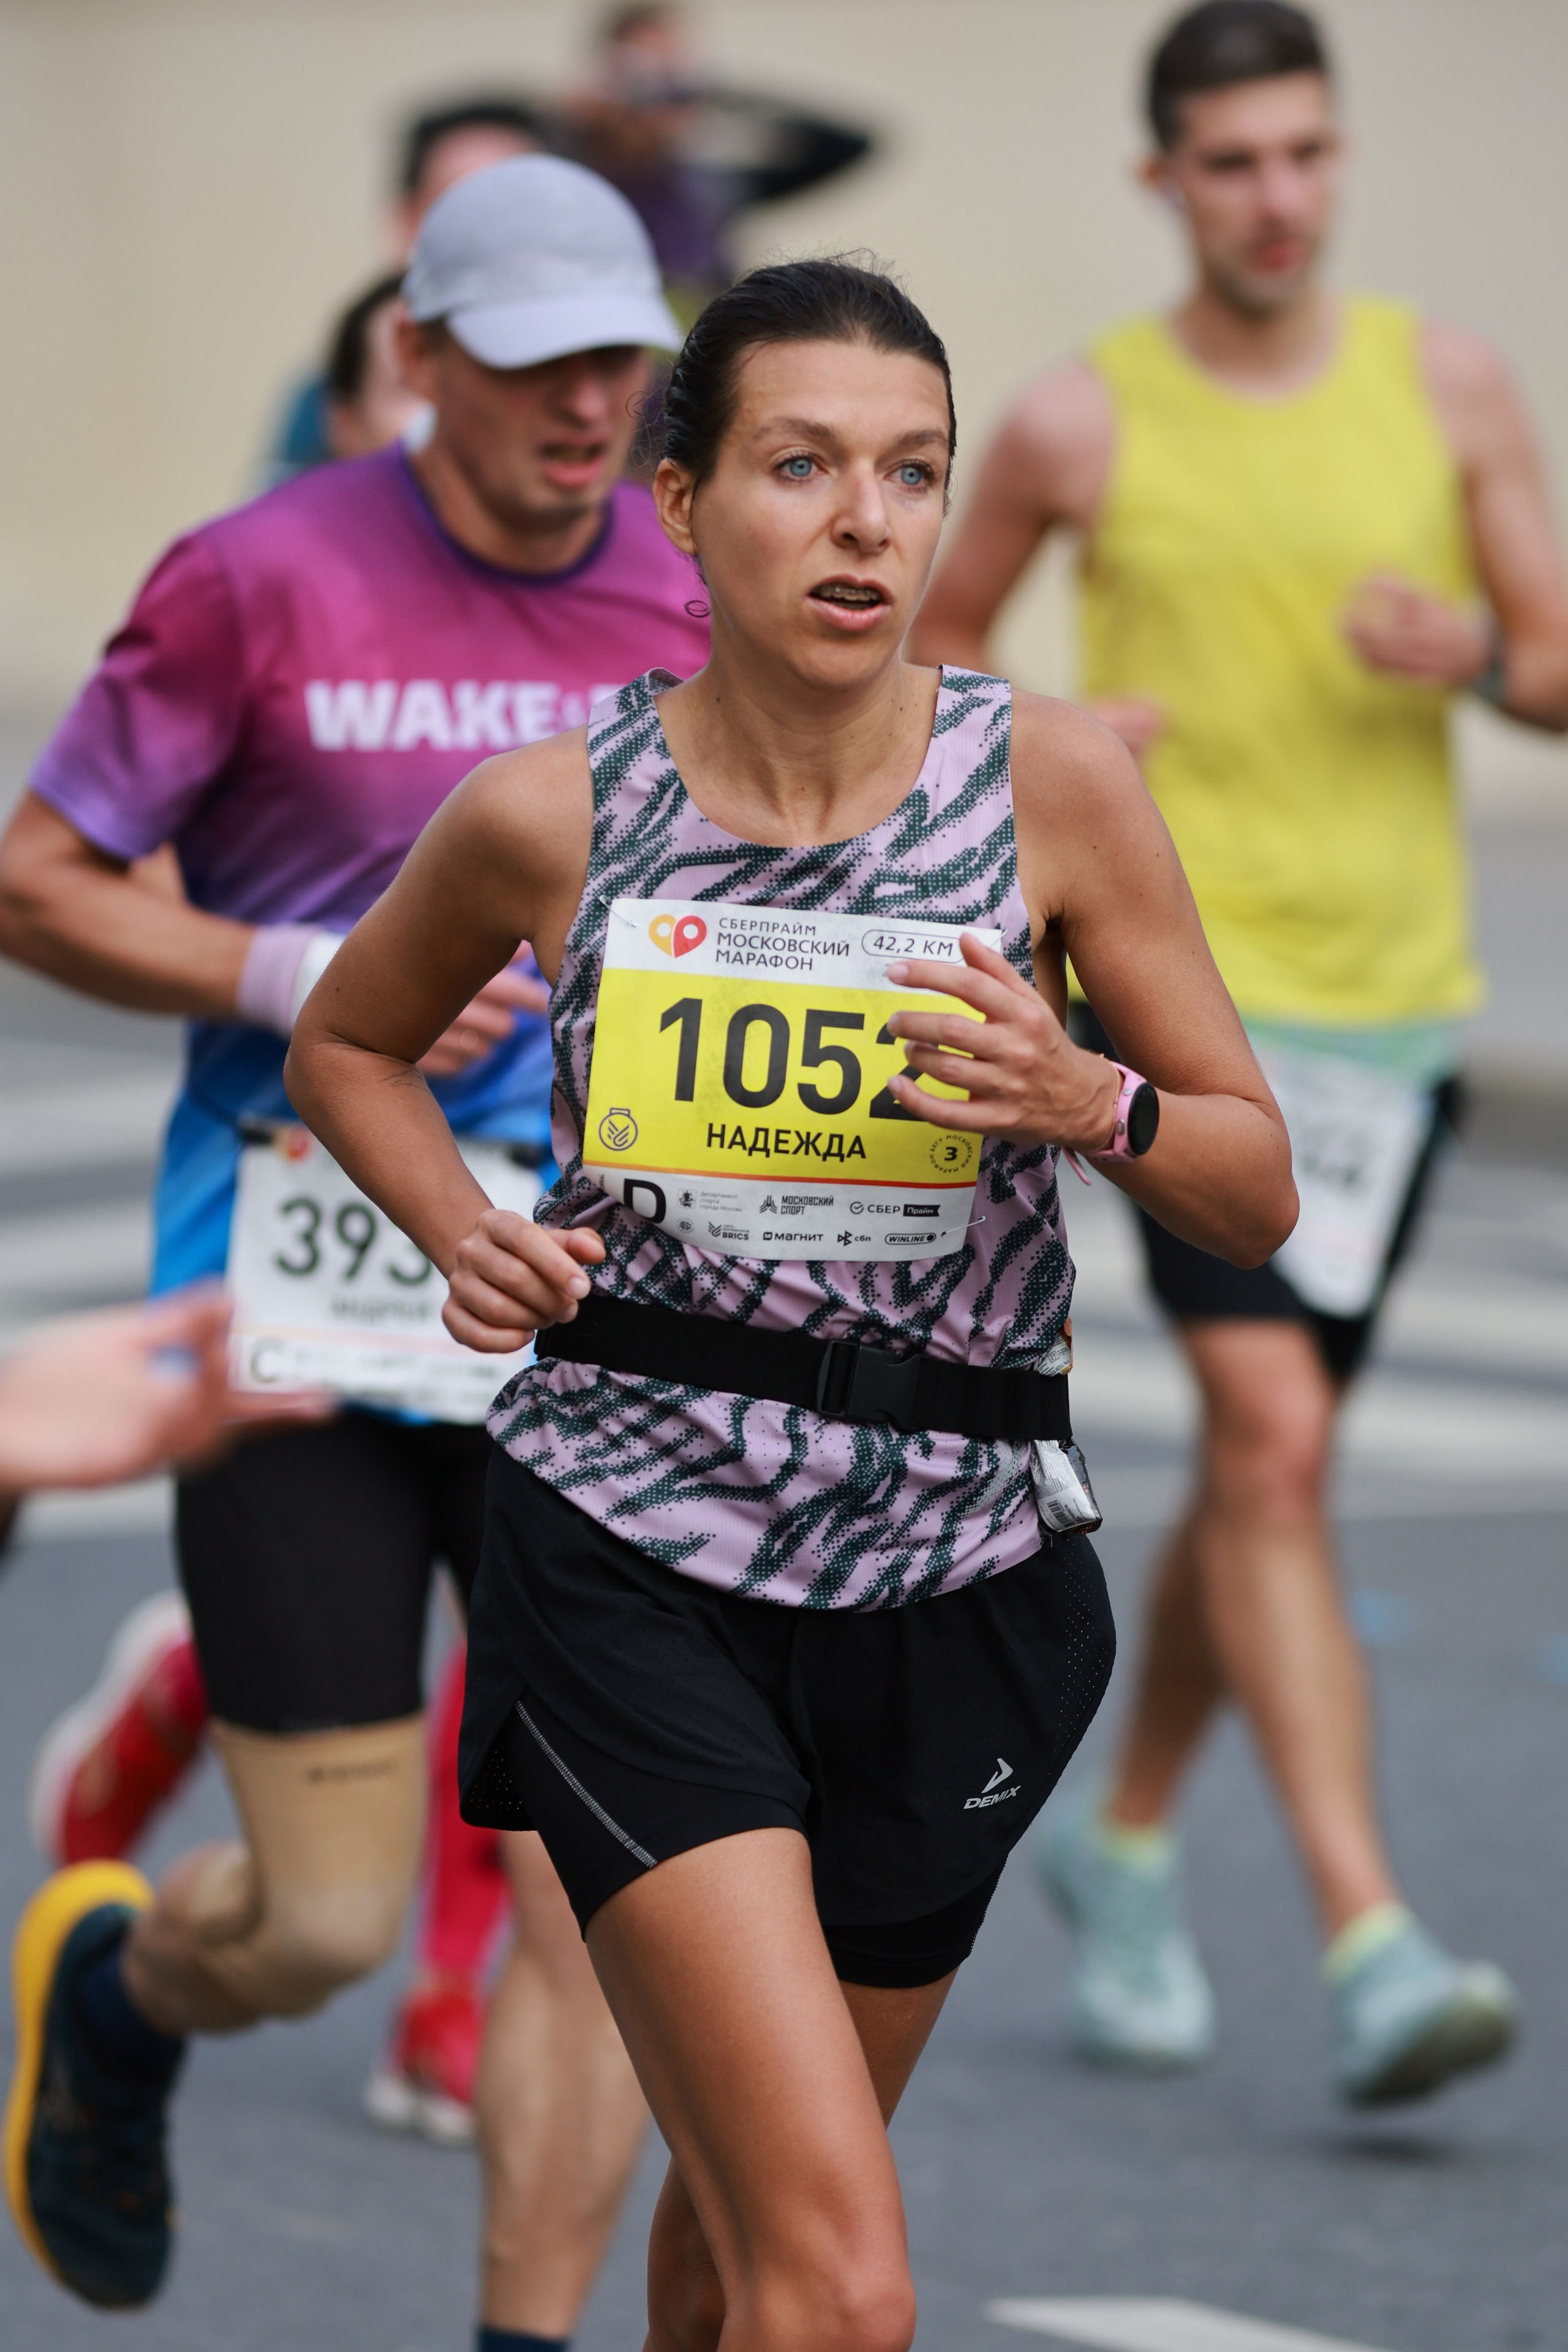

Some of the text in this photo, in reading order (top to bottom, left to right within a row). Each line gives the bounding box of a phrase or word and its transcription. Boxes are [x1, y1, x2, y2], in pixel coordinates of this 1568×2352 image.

[304, 678, 560, 752] WAKE
[719, 918, 816, 936] СБЕРПРАЙМ
[717, 932, 850, 957] МОСКОВСКИЙ
[873, 936, 915, 954] 42,2
[715, 949, 813, 971] МАРАФОН
[707, 1123, 866, 1162] НАДЕЖДА
[944, 1146, 958, 1161] 3
[781, 1195, 834, 1207] МОСКОВСКИЙ
[867, 1204, 934, 1215] СБЕР Прайм
[780, 1205, 805, 1216] СПОРТ
[722, 1231, 749, 1241] BRICS
[963, 1785, 1022, 1809] DEMIX
